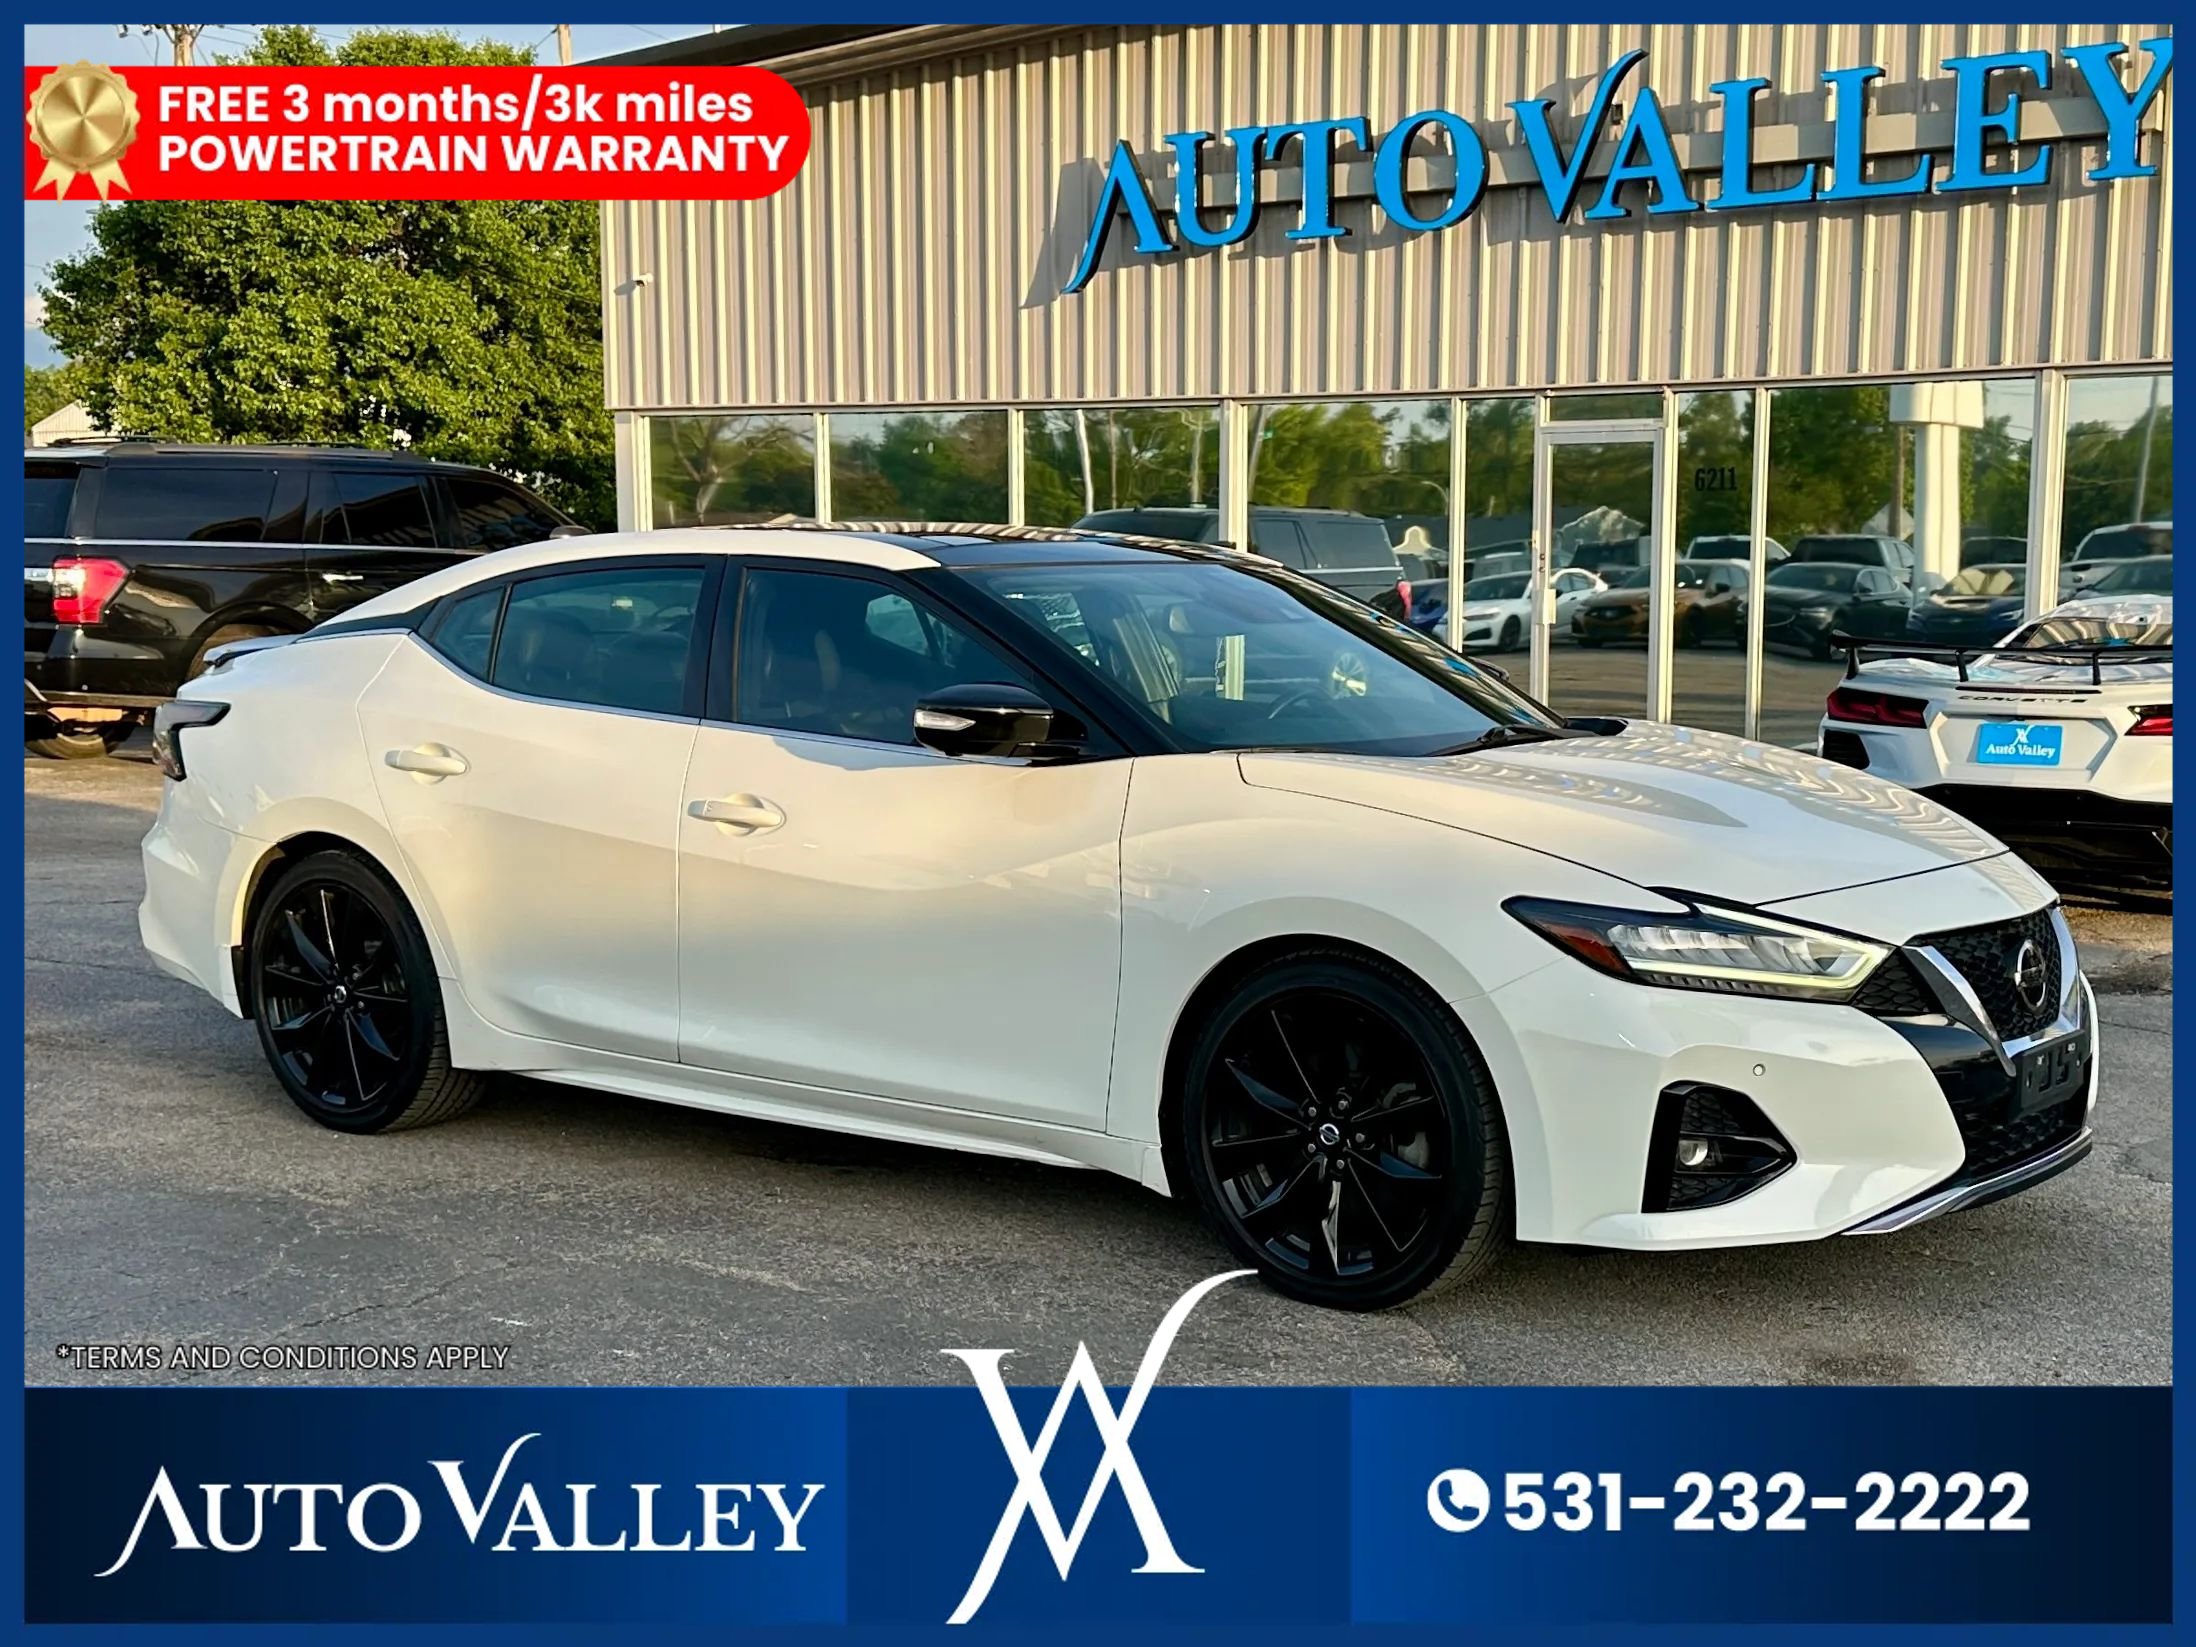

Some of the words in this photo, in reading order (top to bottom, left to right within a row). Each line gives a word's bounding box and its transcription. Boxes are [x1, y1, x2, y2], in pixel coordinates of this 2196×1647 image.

[1062, 109, 1487, 294] AUTO
[1508, 37, 2172, 223] VALLEY
[1694, 466, 1739, 491] 6211
[1985, 744, 2016, 755] Auto
[2017, 744, 2056, 759] Valley
